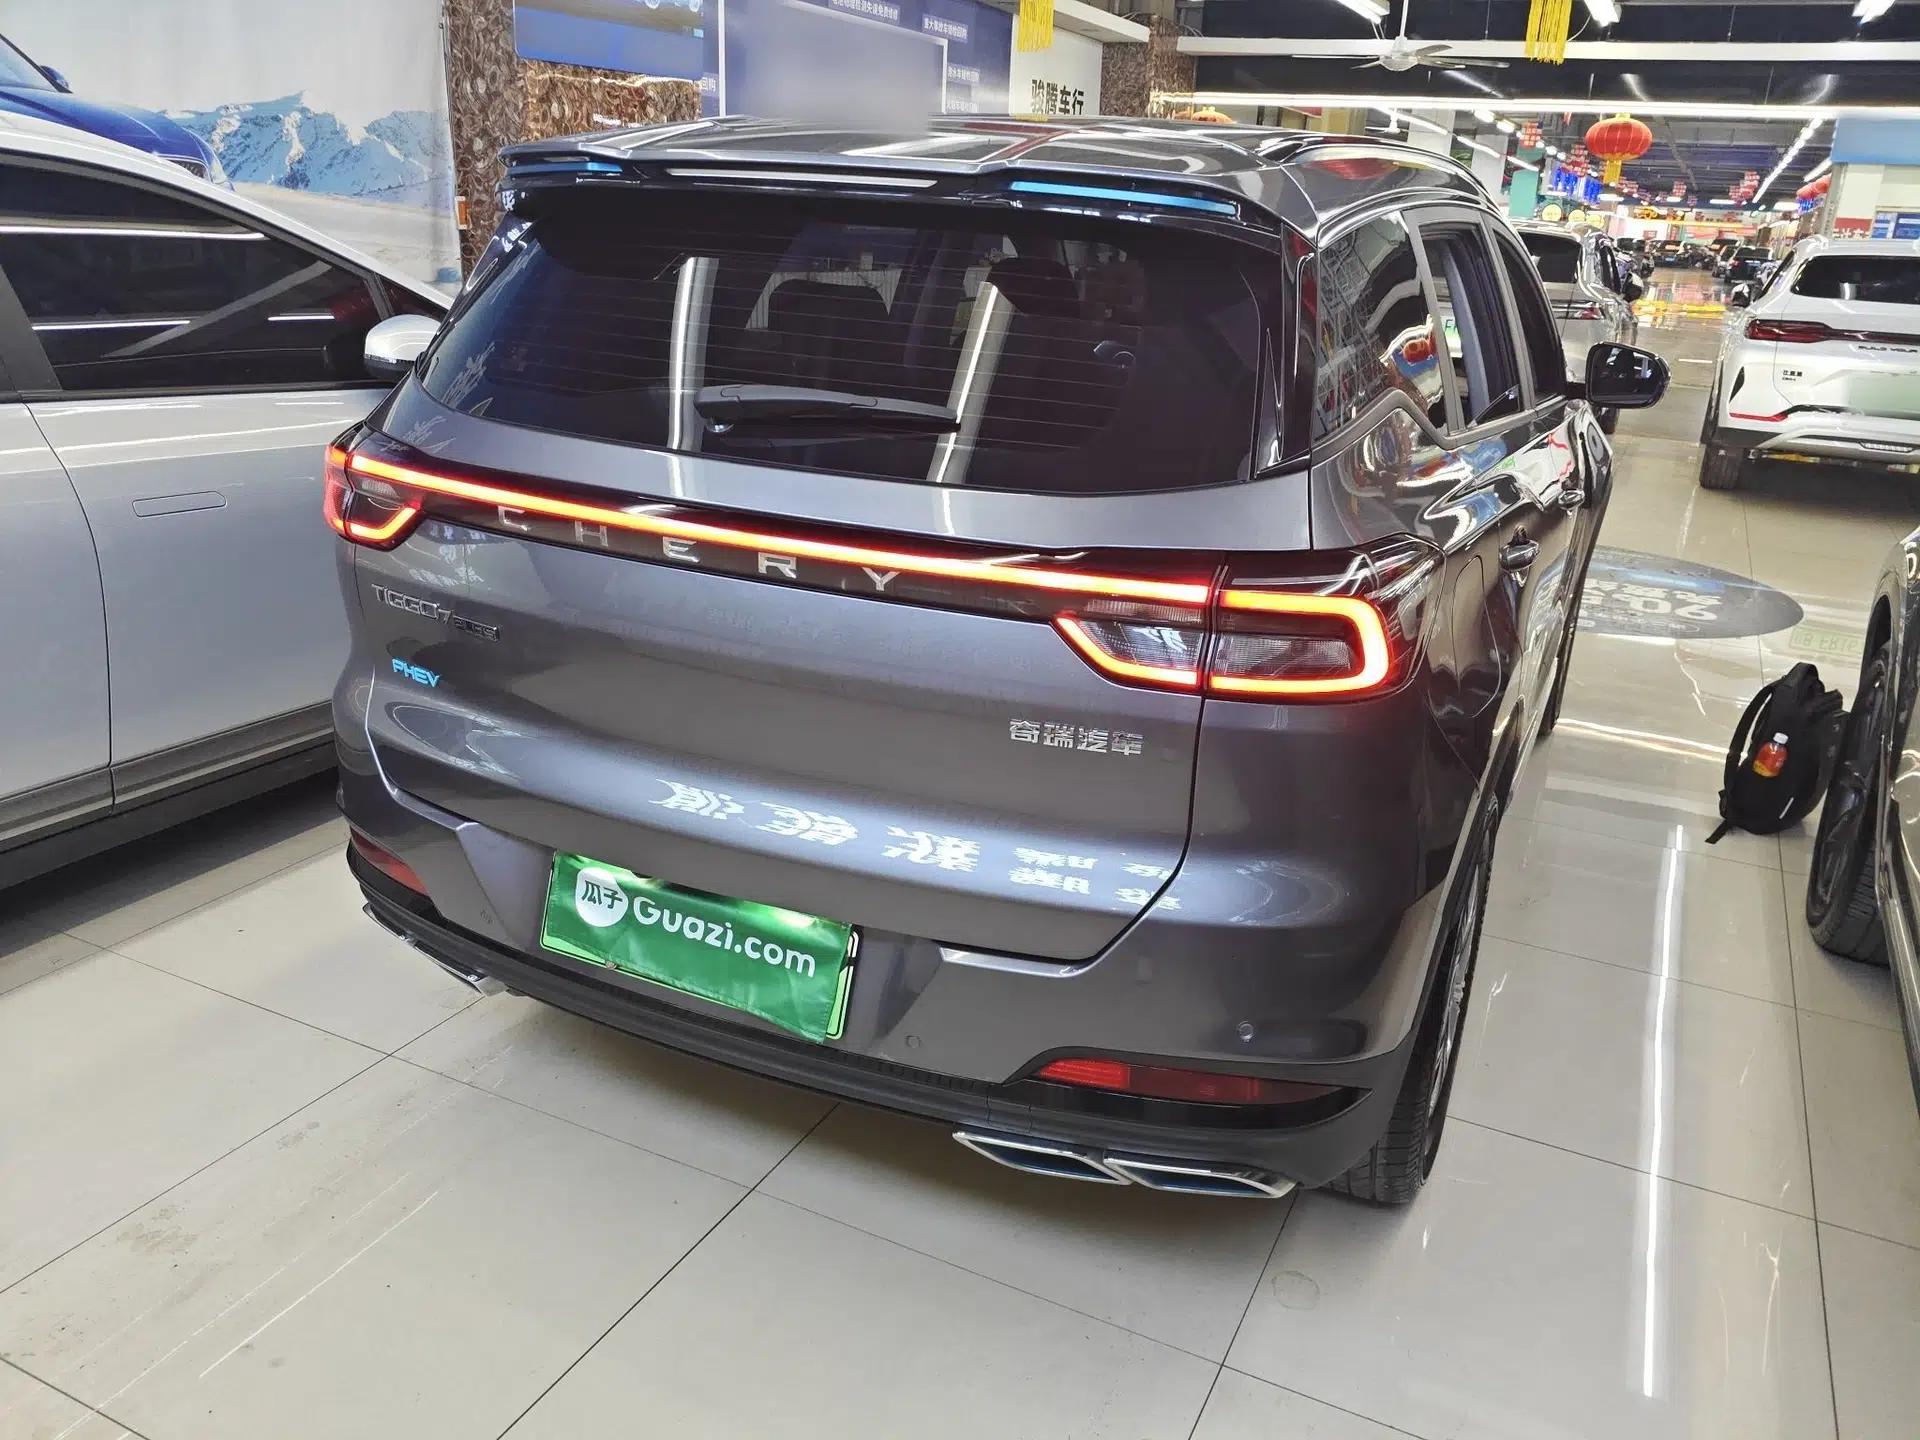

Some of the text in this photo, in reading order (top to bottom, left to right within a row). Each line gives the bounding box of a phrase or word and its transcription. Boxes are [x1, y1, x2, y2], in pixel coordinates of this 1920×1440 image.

[496, 503, 903, 592] CHERY
[391, 657, 443, 689] PHEV
[1008, 717, 1145, 758] 奇瑞汽车
[581, 878, 817, 979] 瓜子 Guazi.com
